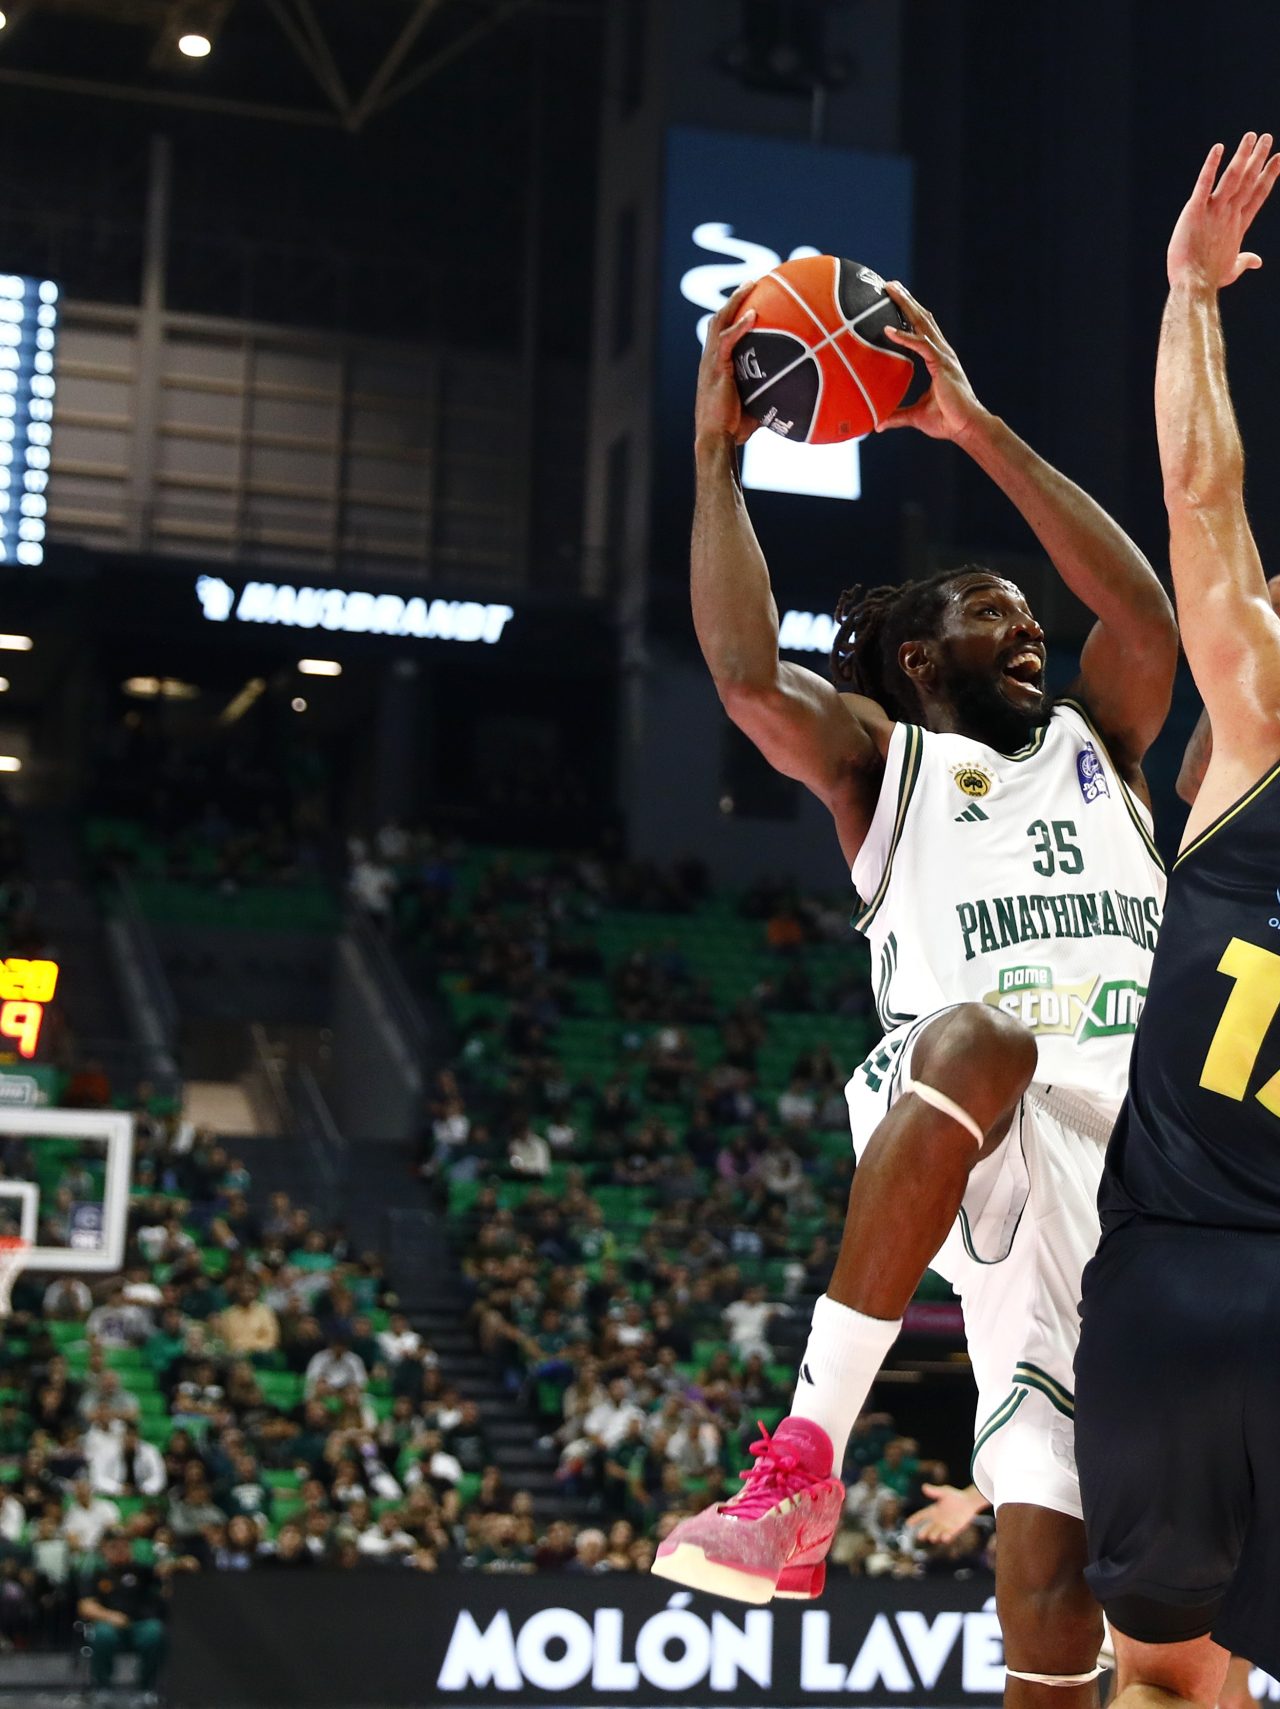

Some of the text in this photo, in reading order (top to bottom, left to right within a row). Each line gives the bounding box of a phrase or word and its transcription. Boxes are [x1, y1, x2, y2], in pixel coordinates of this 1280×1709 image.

[1027, 819, 1084, 878] 35
[956, 889, 1161, 962] PANATHINAKOS
[1003, 968, 1048, 990] pame
[437, 1591, 773, 1692] MOLÓN
